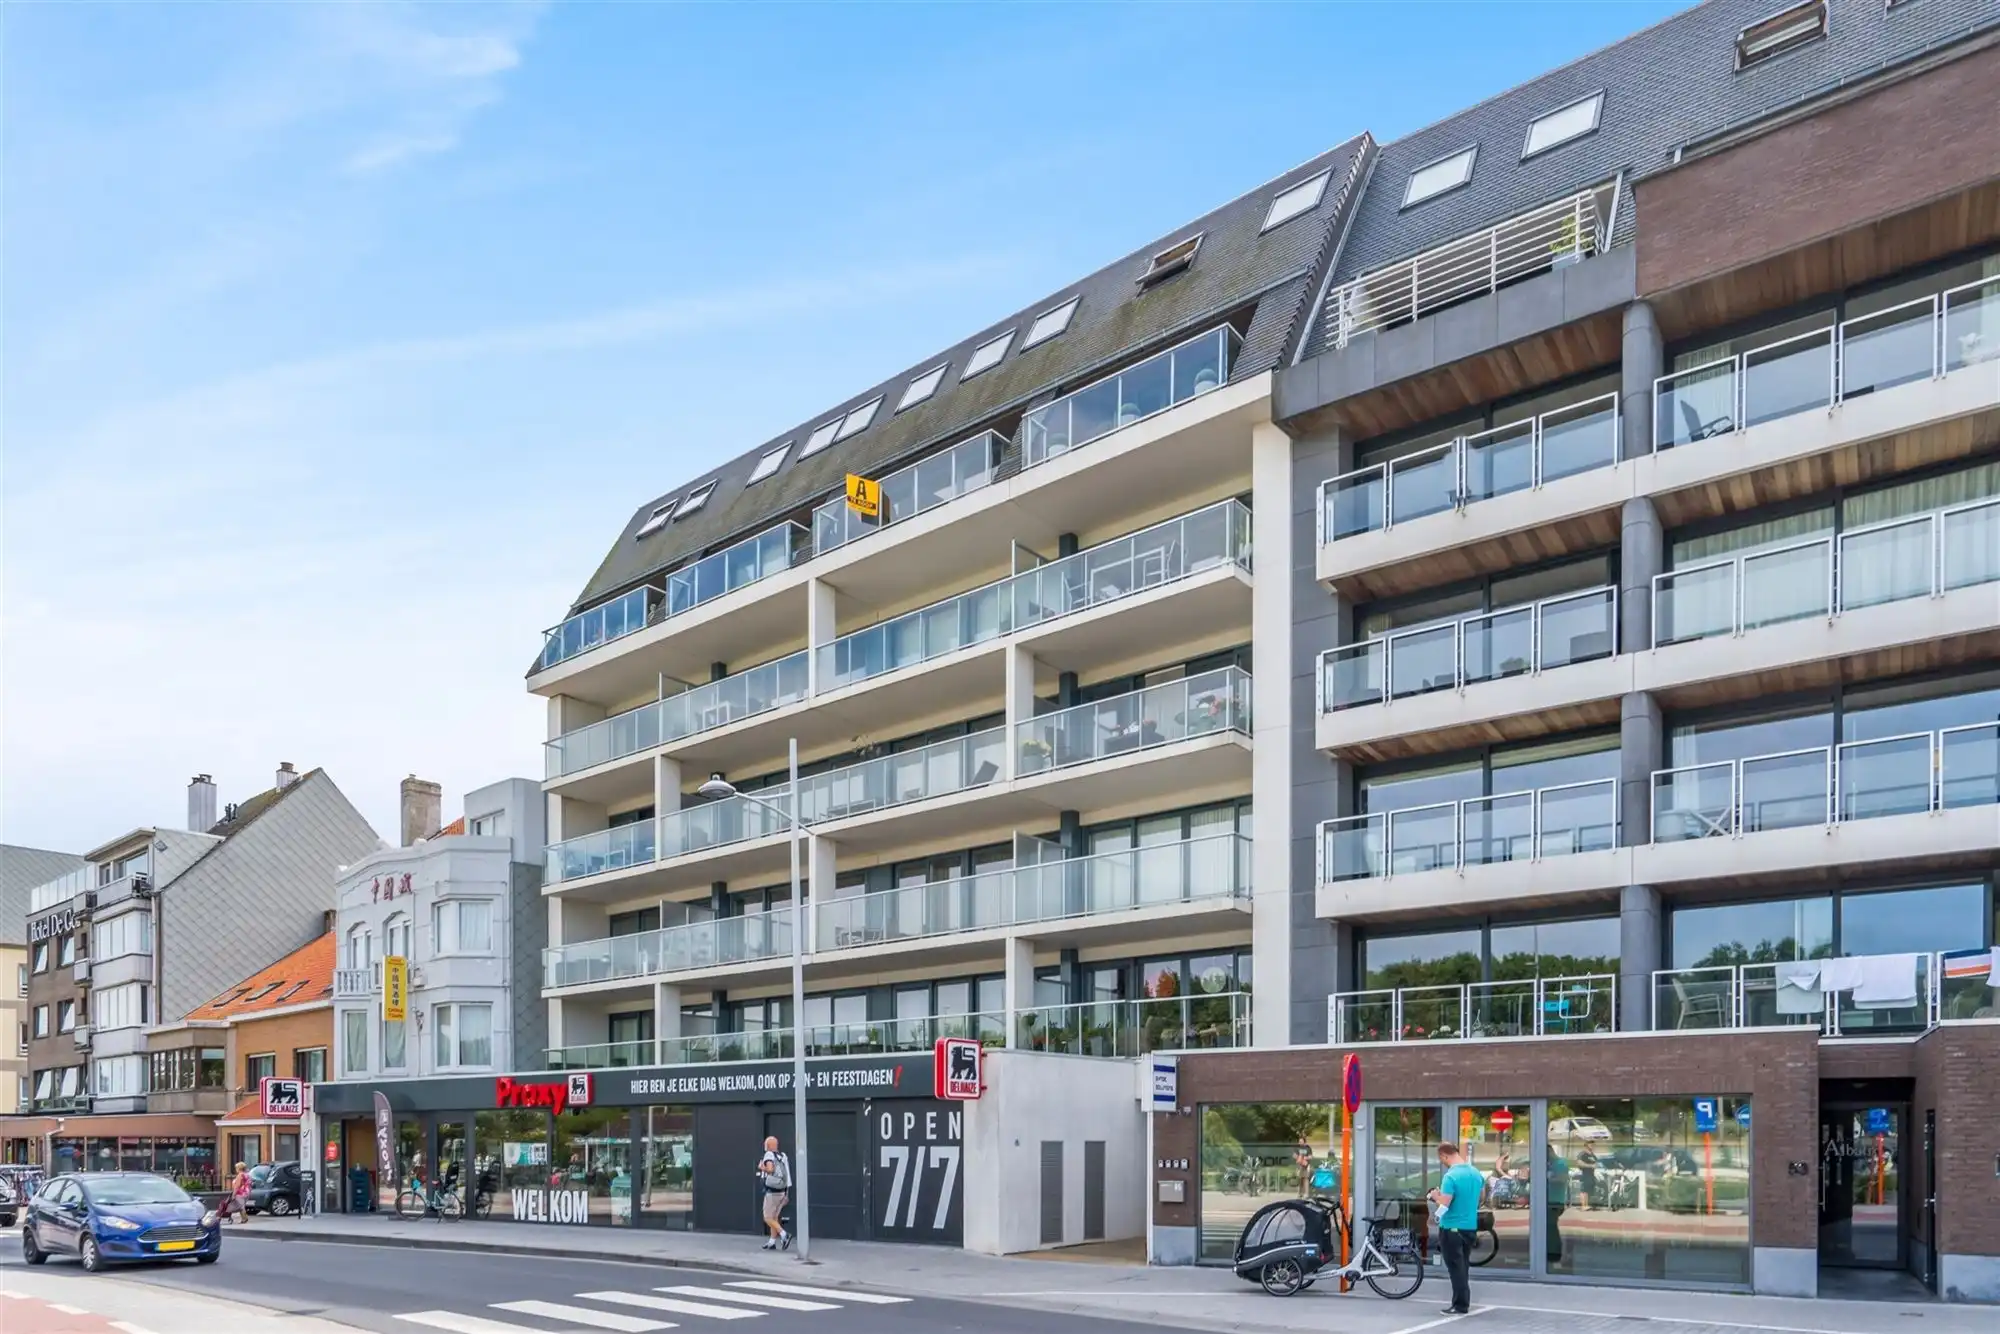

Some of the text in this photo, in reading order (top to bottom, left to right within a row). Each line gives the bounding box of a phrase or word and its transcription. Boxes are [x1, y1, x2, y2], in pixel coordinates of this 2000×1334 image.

[856, 480, 867, 500] A
[31, 915, 50, 942] Hotel
[51, 914, 63, 936] De
[496, 1076, 567, 1116] Proxy
[631, 1080, 648, 1093] HIER
[650, 1079, 665, 1092] BEN
[667, 1078, 677, 1092] JE
[679, 1078, 698, 1092] ELKE
[700, 1077, 716, 1091] DAG
[718, 1075, 757, 1091] WELKOM,
[758, 1074, 776, 1089] OOK
[778, 1073, 791, 1089] OP
[817, 1071, 829, 1087] EN
[950, 1082, 977, 1094] DELHAIZE
[269, 1104, 299, 1113] DELHAIZE
[880, 1111, 961, 1140] OPEN
[880, 1146, 961, 1230] 7/7
[511, 1188, 588, 1223] WELKOM
